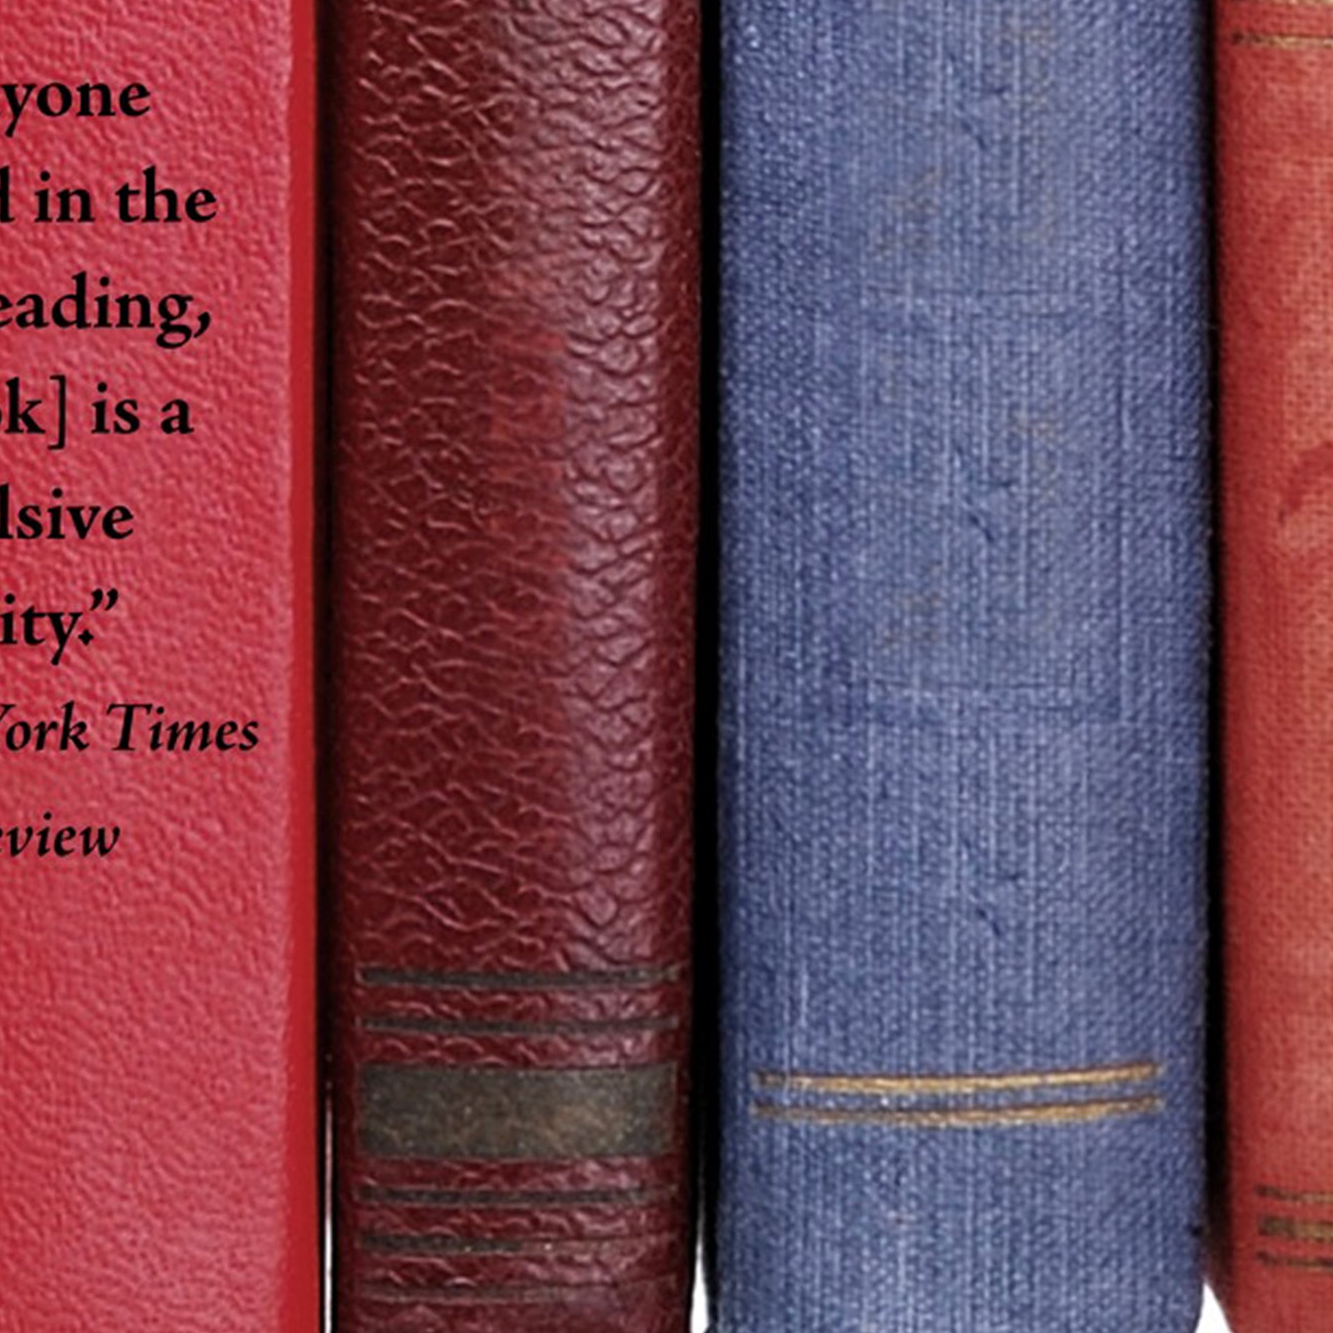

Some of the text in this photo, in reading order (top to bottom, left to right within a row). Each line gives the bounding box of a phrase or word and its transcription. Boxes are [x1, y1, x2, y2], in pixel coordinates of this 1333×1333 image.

[35, 169, 95, 224] in
[115, 165, 218, 224] the
[91, 381, 140, 435] is
[160, 397, 195, 435] a
[106, 702, 260, 753] Times
